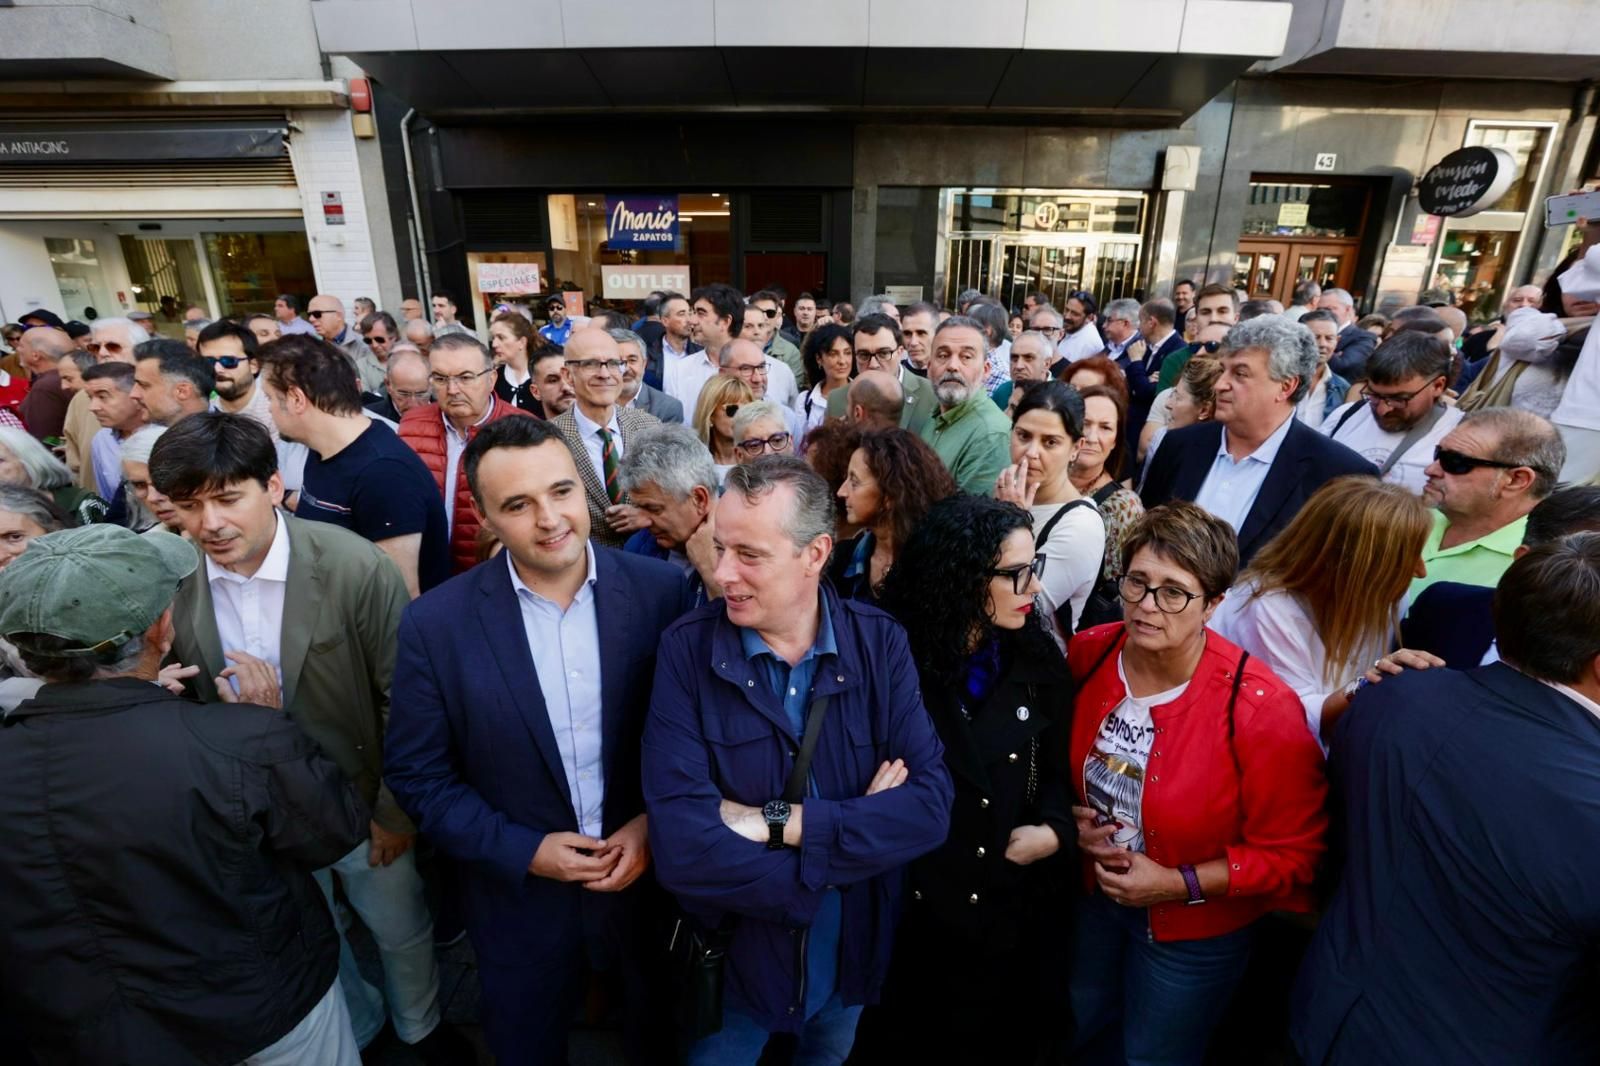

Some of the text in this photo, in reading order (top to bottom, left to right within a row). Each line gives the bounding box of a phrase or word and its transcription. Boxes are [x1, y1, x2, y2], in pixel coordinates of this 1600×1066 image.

[11, 141, 69, 154] ANTIAGING
[1318, 156, 1334, 168] 43
[610, 200, 675, 239] Mario
[632, 233, 673, 242] ZAPATOS
[480, 273, 537, 291] ESPECIALES
[607, 274, 685, 289] OUTLET
